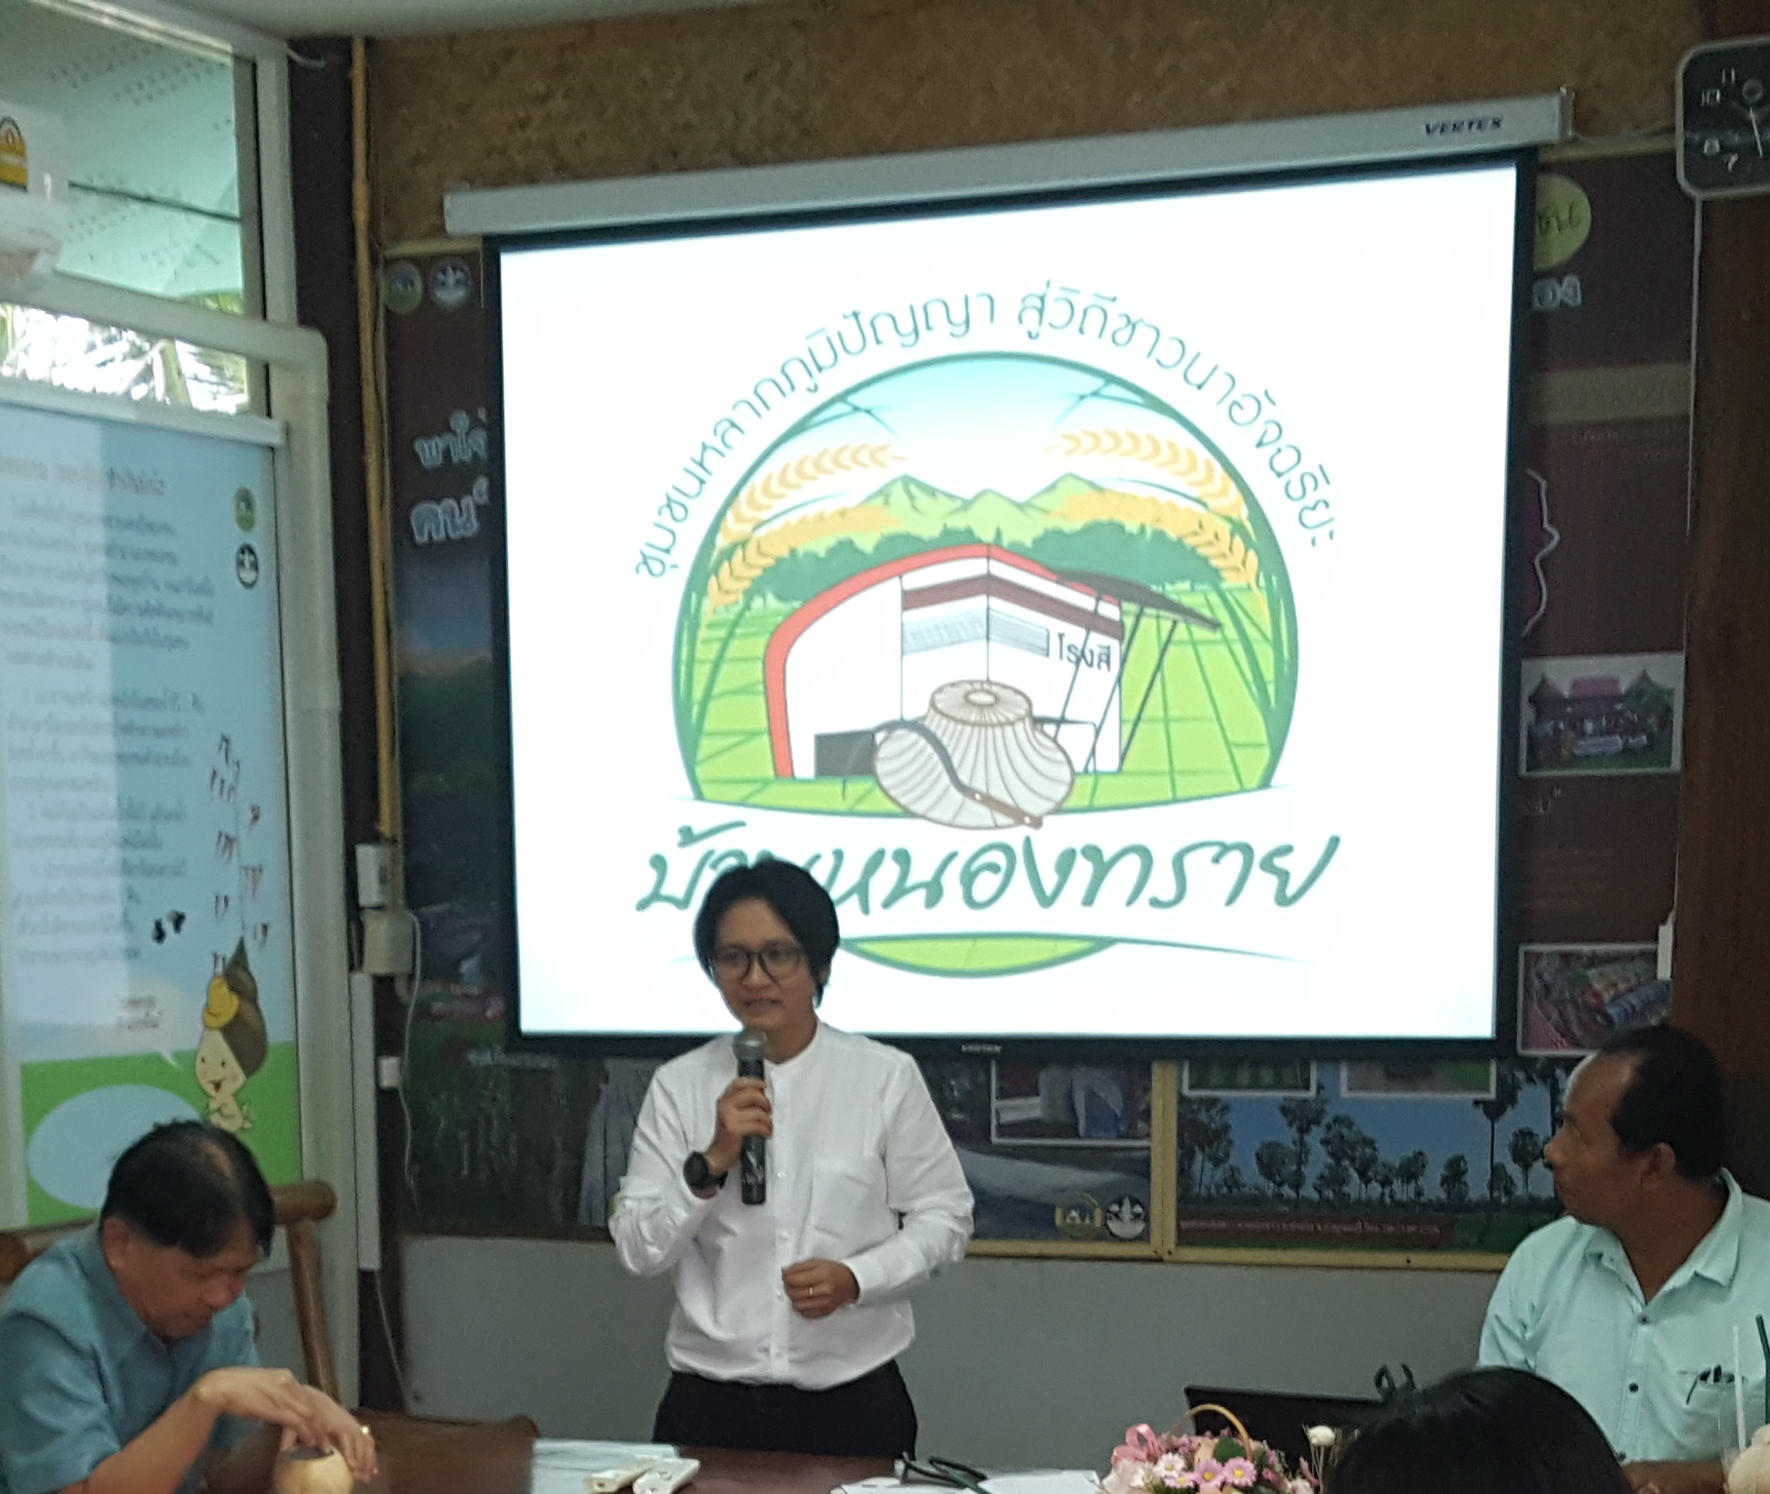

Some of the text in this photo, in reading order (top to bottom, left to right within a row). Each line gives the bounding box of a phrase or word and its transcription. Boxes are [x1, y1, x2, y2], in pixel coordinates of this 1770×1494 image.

[634, 278, 1341, 582] ชุมชนหลากภูมิปัญญา สู่วิถีชาวนาอัจฉริยะ
[1052, 631, 1116, 676] โรงสี
[634, 820, 1343, 916] บ้หนองทราย
